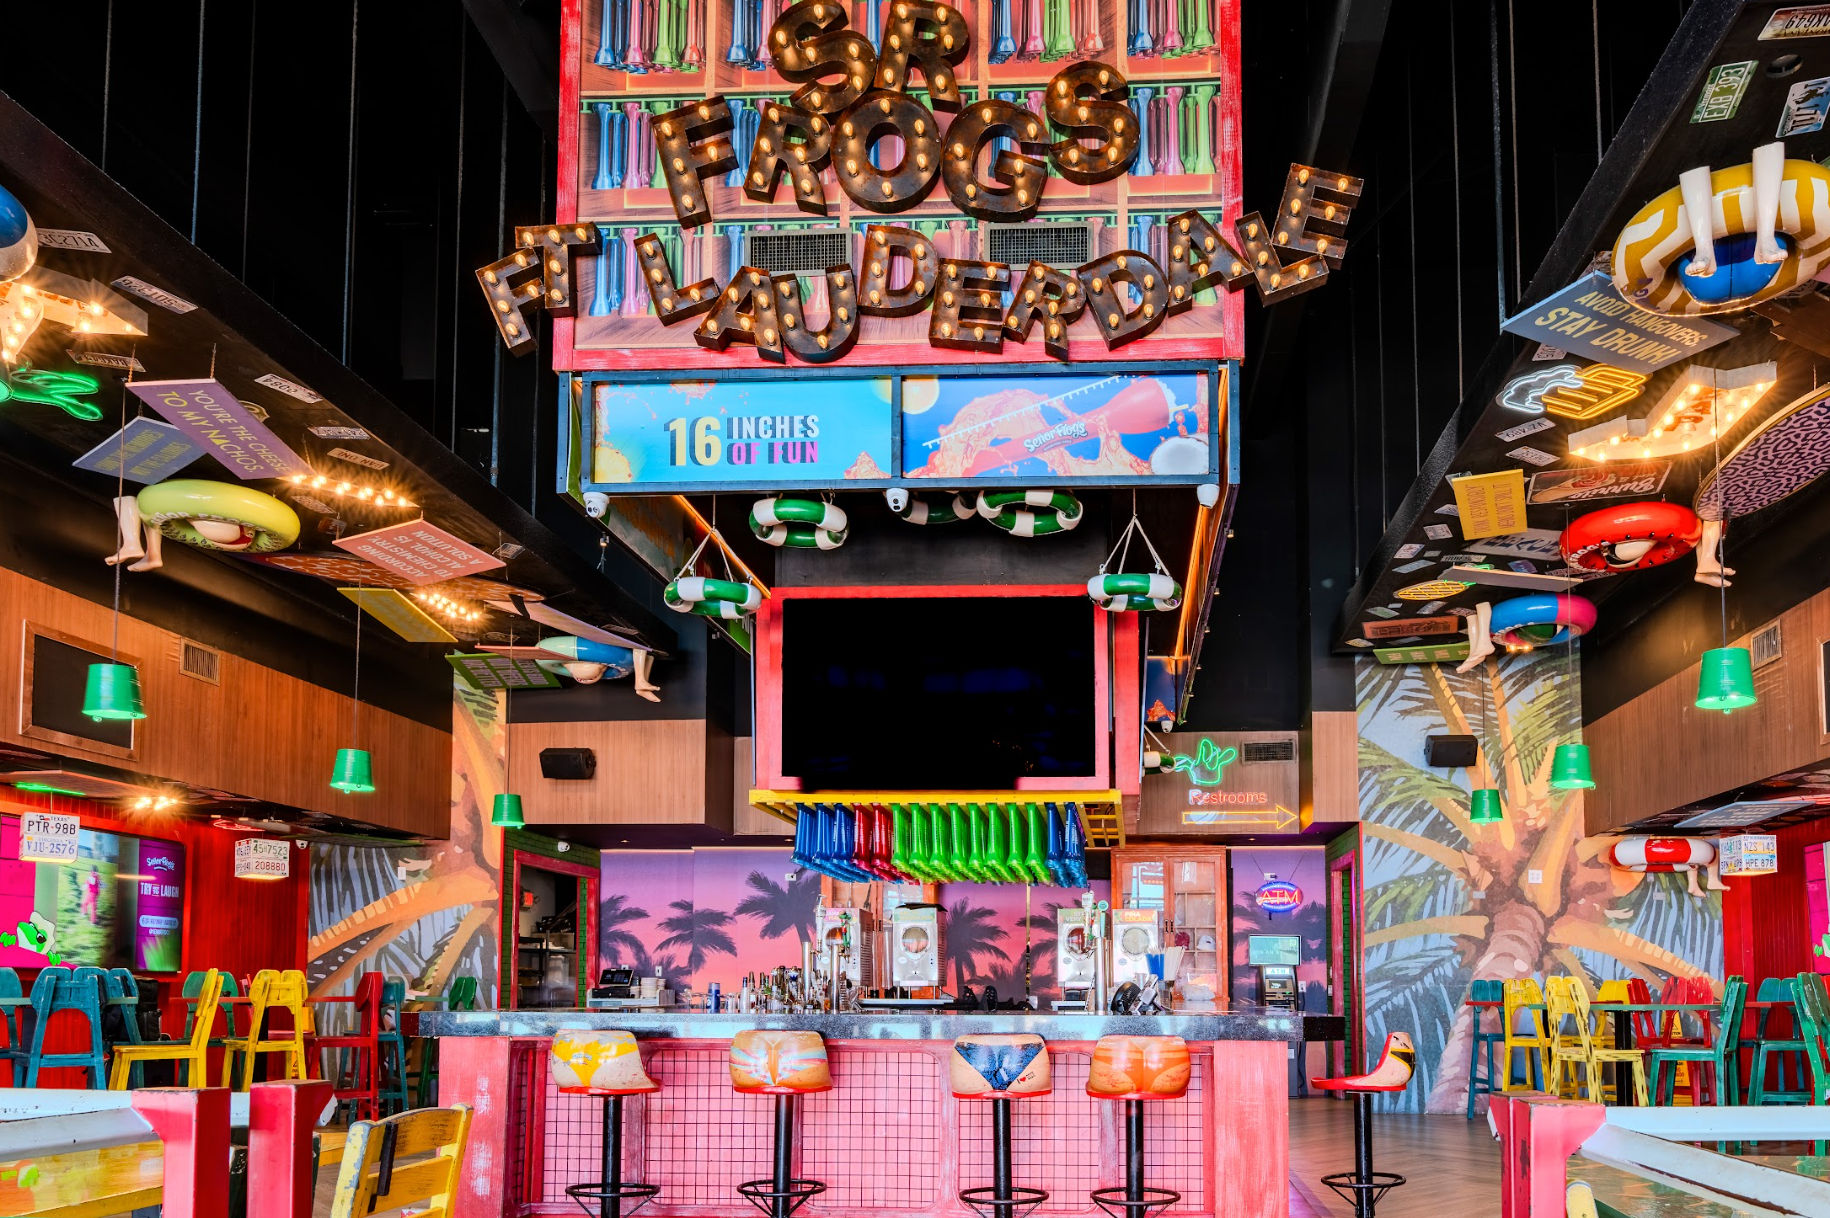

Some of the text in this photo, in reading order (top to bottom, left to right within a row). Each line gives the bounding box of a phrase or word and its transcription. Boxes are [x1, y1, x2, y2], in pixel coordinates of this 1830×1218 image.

[1714, 67, 1745, 91] 393
[1703, 95, 1733, 118] EXB
[650, 60, 1140, 229] FROGS
[475, 163, 1364, 364] FT LAUDERDALE
[1574, 291, 1630, 316] AVOID
[1534, 307, 1608, 338] STAY
[1589, 327, 1682, 364] DRUNK!
[157, 391, 188, 408] TO
[178, 411, 213, 431] MY
[188, 390, 238, 426] YOU'RE
[231, 425, 257, 443] THE
[666, 415, 819, 466] 16 INCHES
[729, 441, 818, 464] OF FUN
[394, 535, 466, 569] ALCOHOL IS
[412, 530, 473, 560] SOLUTION
[357, 544, 431, 577] ACCORDING
[434, 568, 454, 578] TO
[1189, 789, 1268, 806] Restrooms
[1761, 858, 1774, 868] 878
[140, 882, 152, 895] TRY
[160, 884, 179, 898] LAUGH
[1260, 889, 1300, 904] ATM
